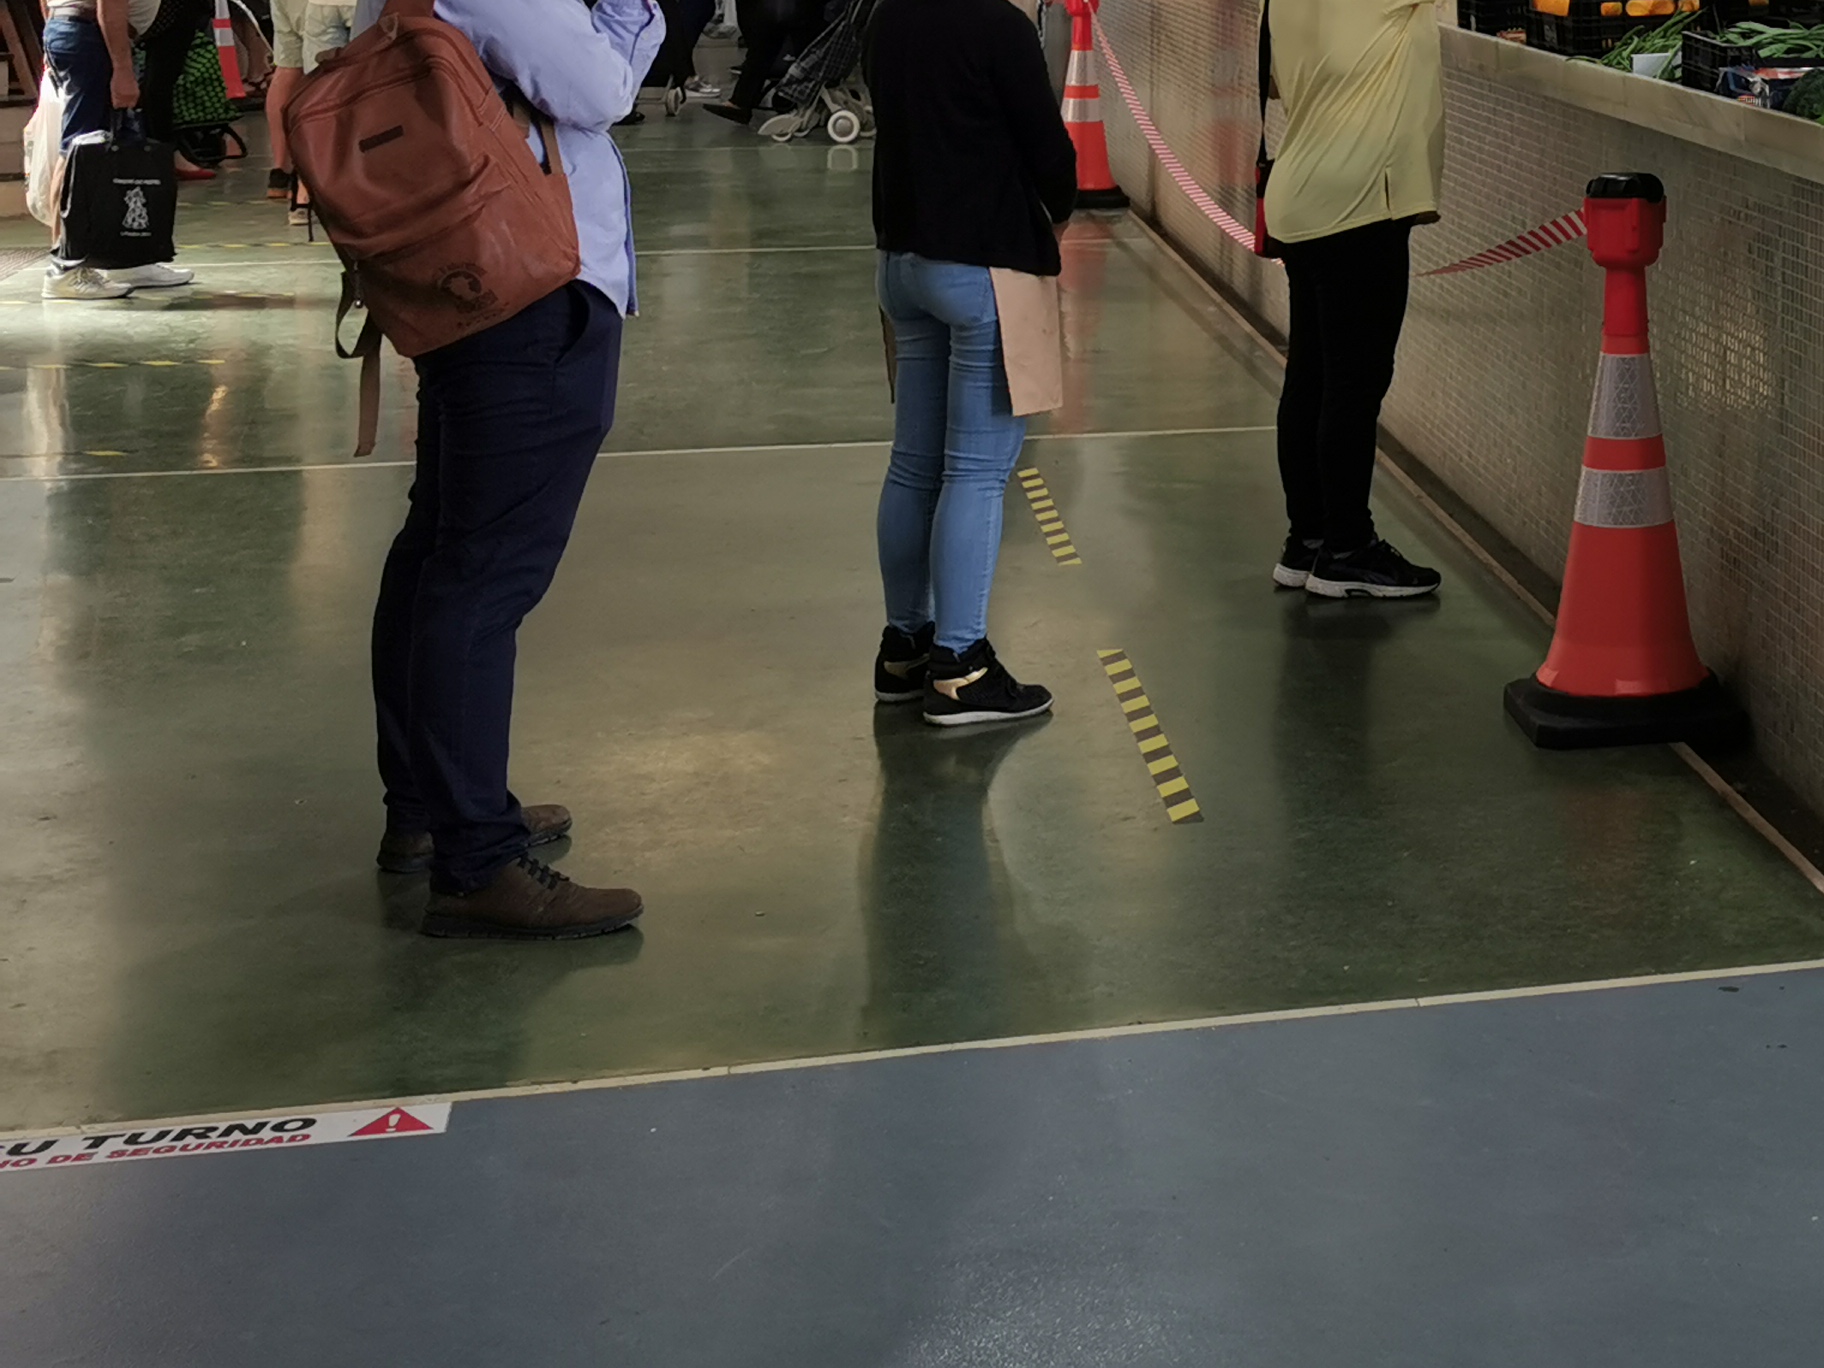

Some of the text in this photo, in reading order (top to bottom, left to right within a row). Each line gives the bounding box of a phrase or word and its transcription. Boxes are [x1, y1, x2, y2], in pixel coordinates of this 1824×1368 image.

[0, 1118, 317, 1157] U TURNO
[46, 1152, 97, 1165] DE
[106, 1133, 311, 1159] SEGURIDAD
